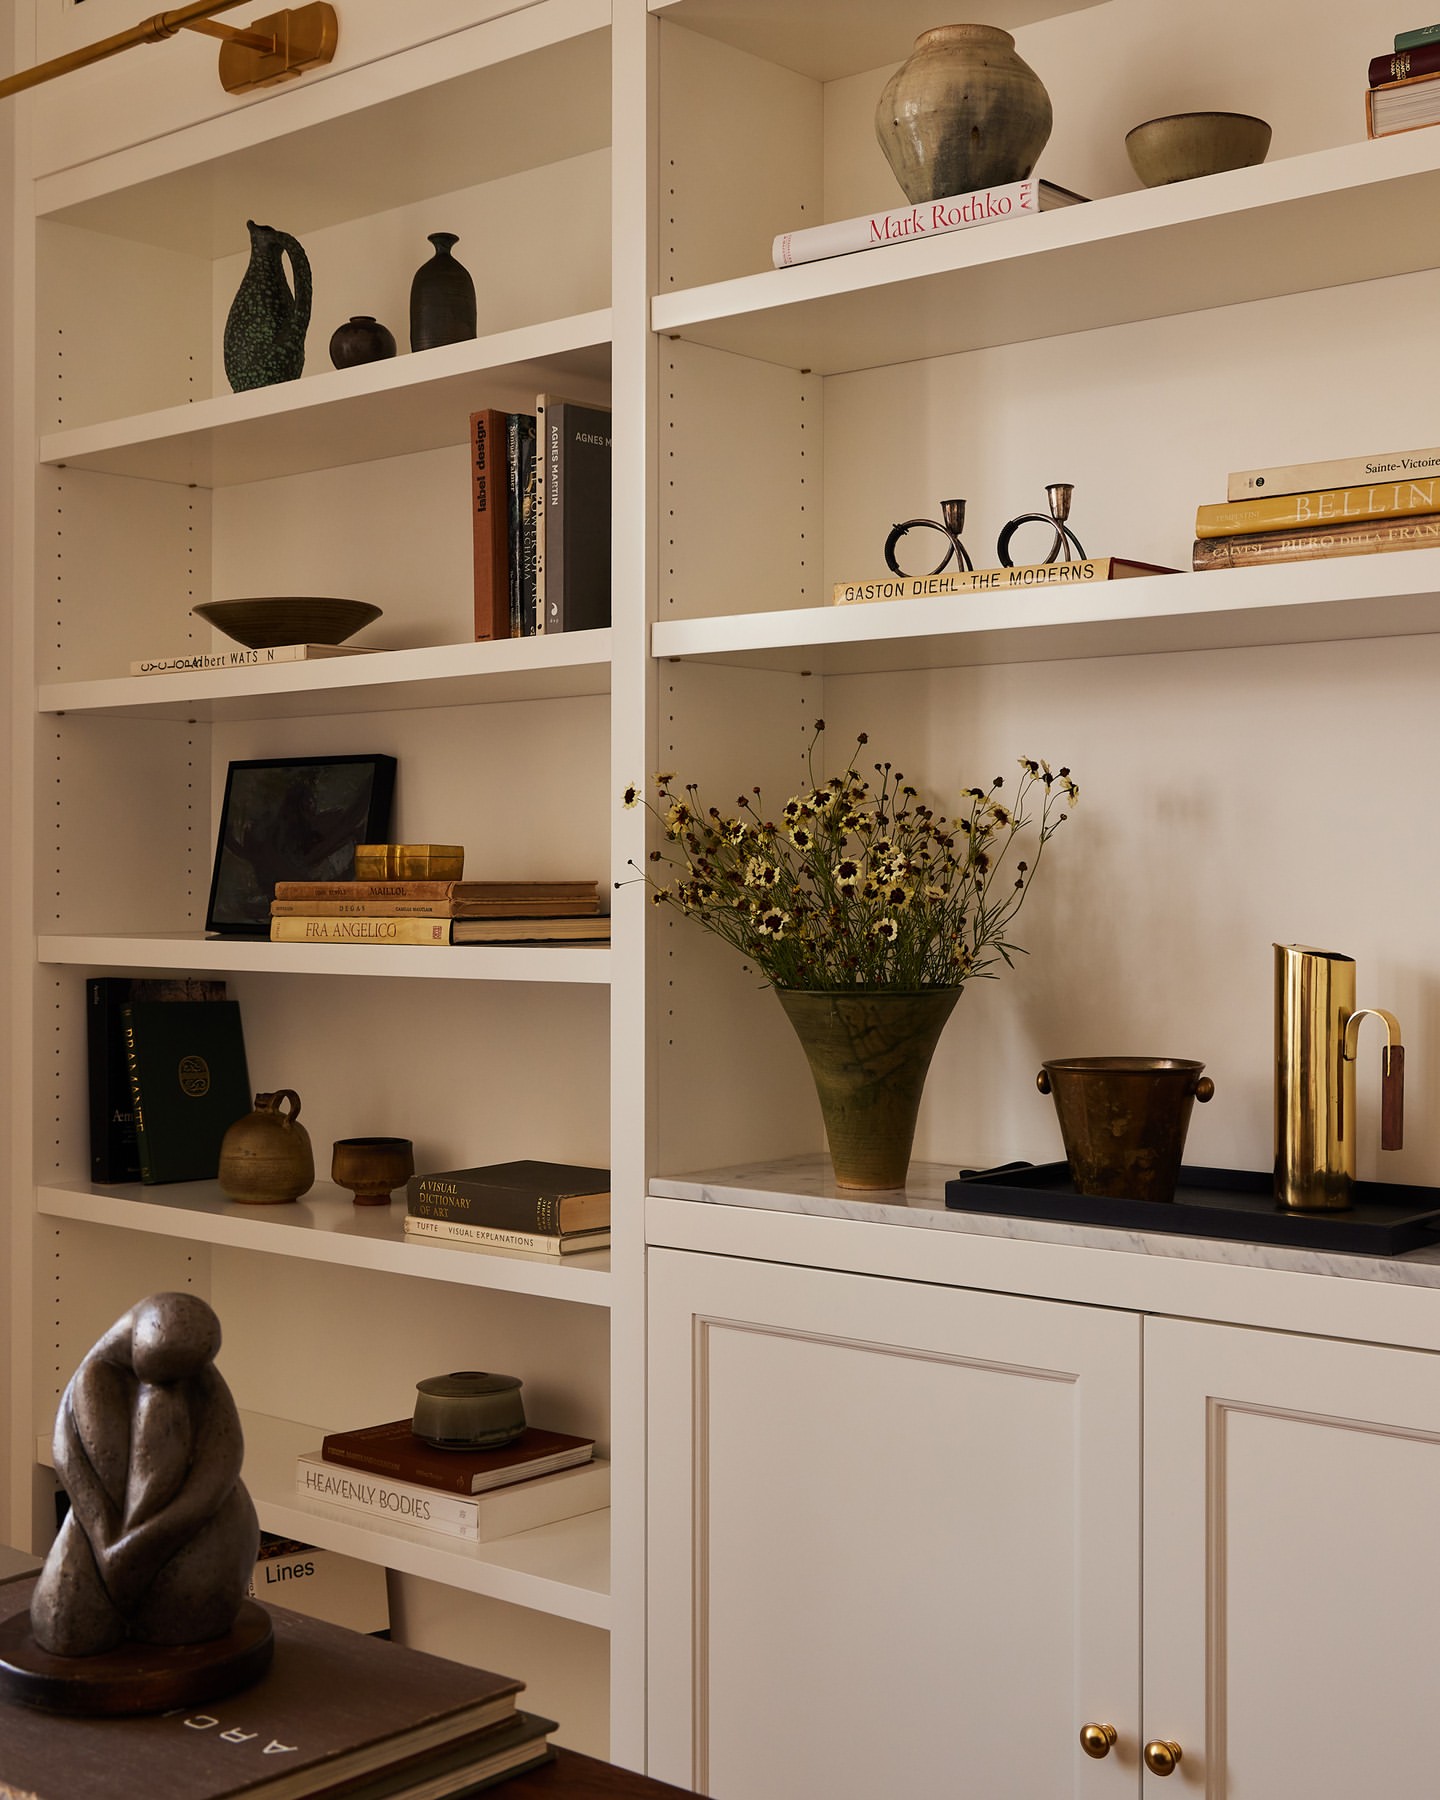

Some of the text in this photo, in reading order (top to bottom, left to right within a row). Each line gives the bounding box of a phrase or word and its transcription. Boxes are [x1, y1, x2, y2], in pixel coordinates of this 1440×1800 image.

[868, 192, 1012, 243] Mark Rothko
[575, 431, 604, 446] AGNES
[475, 419, 487, 513] label design
[551, 425, 559, 506] AGNES MARTIN
[1365, 457, 1440, 474] Sainte-Victoire
[523, 531, 531, 580] SCHAMA
[1212, 544, 1263, 557] CALVESI
[1281, 535, 1334, 551] PIERO
[1340, 532, 1381, 546] DELLA
[845, 582, 905, 601] GASTON
[971, 572, 1001, 590] THE
[1009, 563, 1095, 586] MODERNS
[369, 887, 407, 896] MAILLOL
[305, 922, 397, 938] FRA ANGELICO
[419, 1181, 458, 1195] A VISUAL
[419, 1192, 472, 1209] DICTIONARY
[420, 1205, 449, 1218] OF ART
[416, 1221, 534, 1247] TUFTE VISUAL EXPLANATIONS
[306, 1470, 431, 1520] HEAVENLY BODIES
[265, 1561, 315, 1584] Lines
[162, 1708, 298, 1754] ARC
